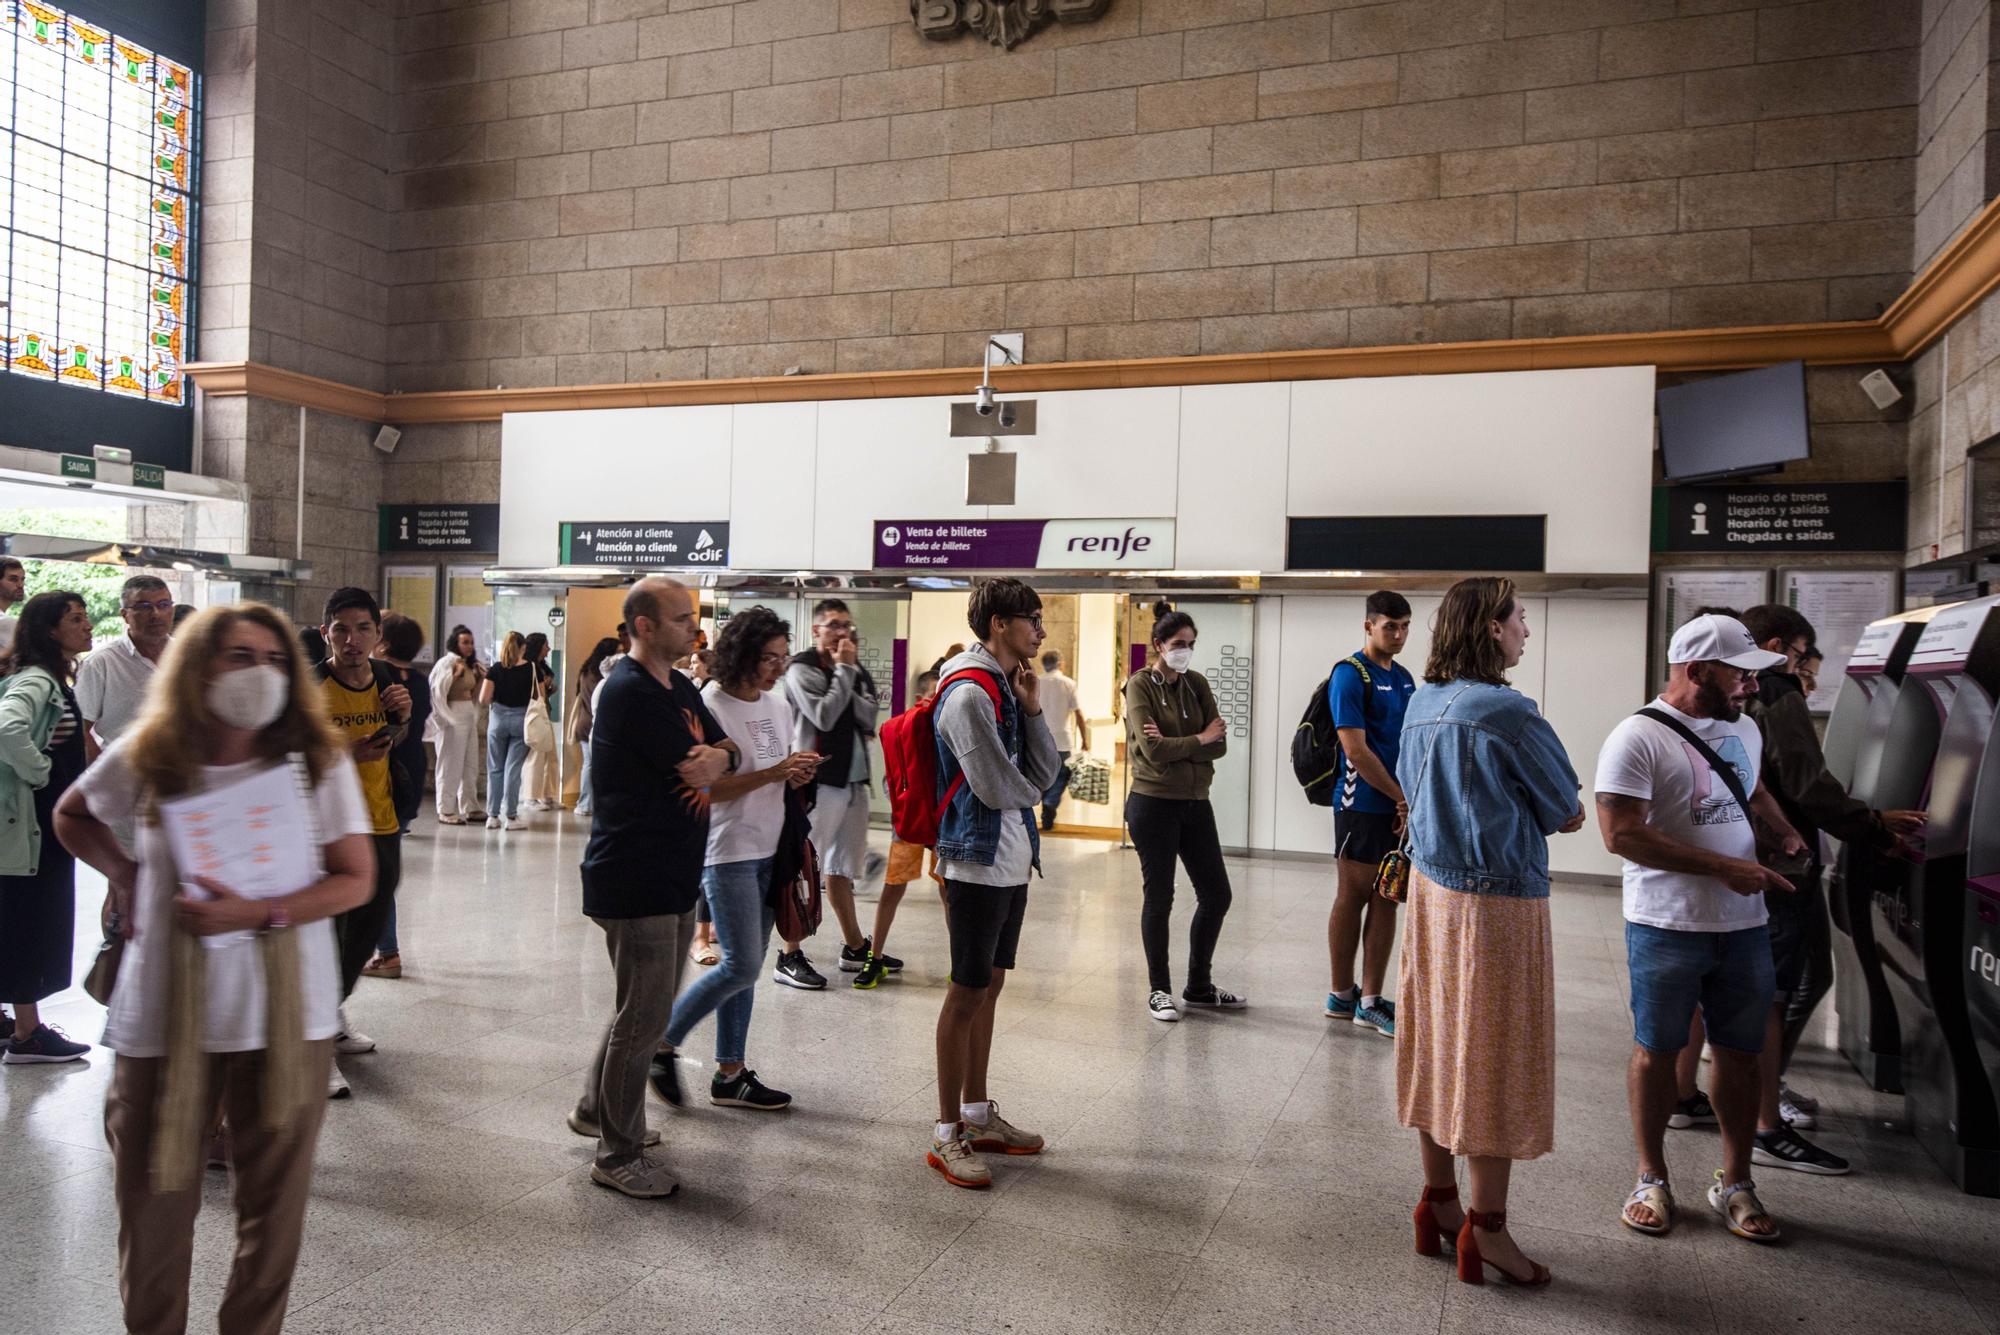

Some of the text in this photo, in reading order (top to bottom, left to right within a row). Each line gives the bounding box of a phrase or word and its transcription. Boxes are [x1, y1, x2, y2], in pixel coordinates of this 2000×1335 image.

[1728, 492, 1828, 503] Horario de trenes
[418, 510, 439, 518] Horario
[1727, 503, 1830, 518] Llegadas y salidas
[1727, 517, 1824, 529] Horario de trens
[417, 528, 440, 536] Horario
[596, 528, 673, 539] Atención al cliente
[906, 526, 988, 538] Venta de billetes
[1726, 531, 1783, 544] Chegadas
[1785, 532, 1794, 541] e
[417, 537, 446, 546] Chegadas
[595, 541, 678, 553] Atención ao cliente
[905, 541, 971, 551] Venda de billetes
[1067, 527, 1152, 561] renfe
[595, 555, 665, 563] CUSTOMER SERVICE
[687, 549, 723, 562] adif
[905, 554, 949, 565] Tickets sale
[332, 712, 385, 727] ORIGINA
